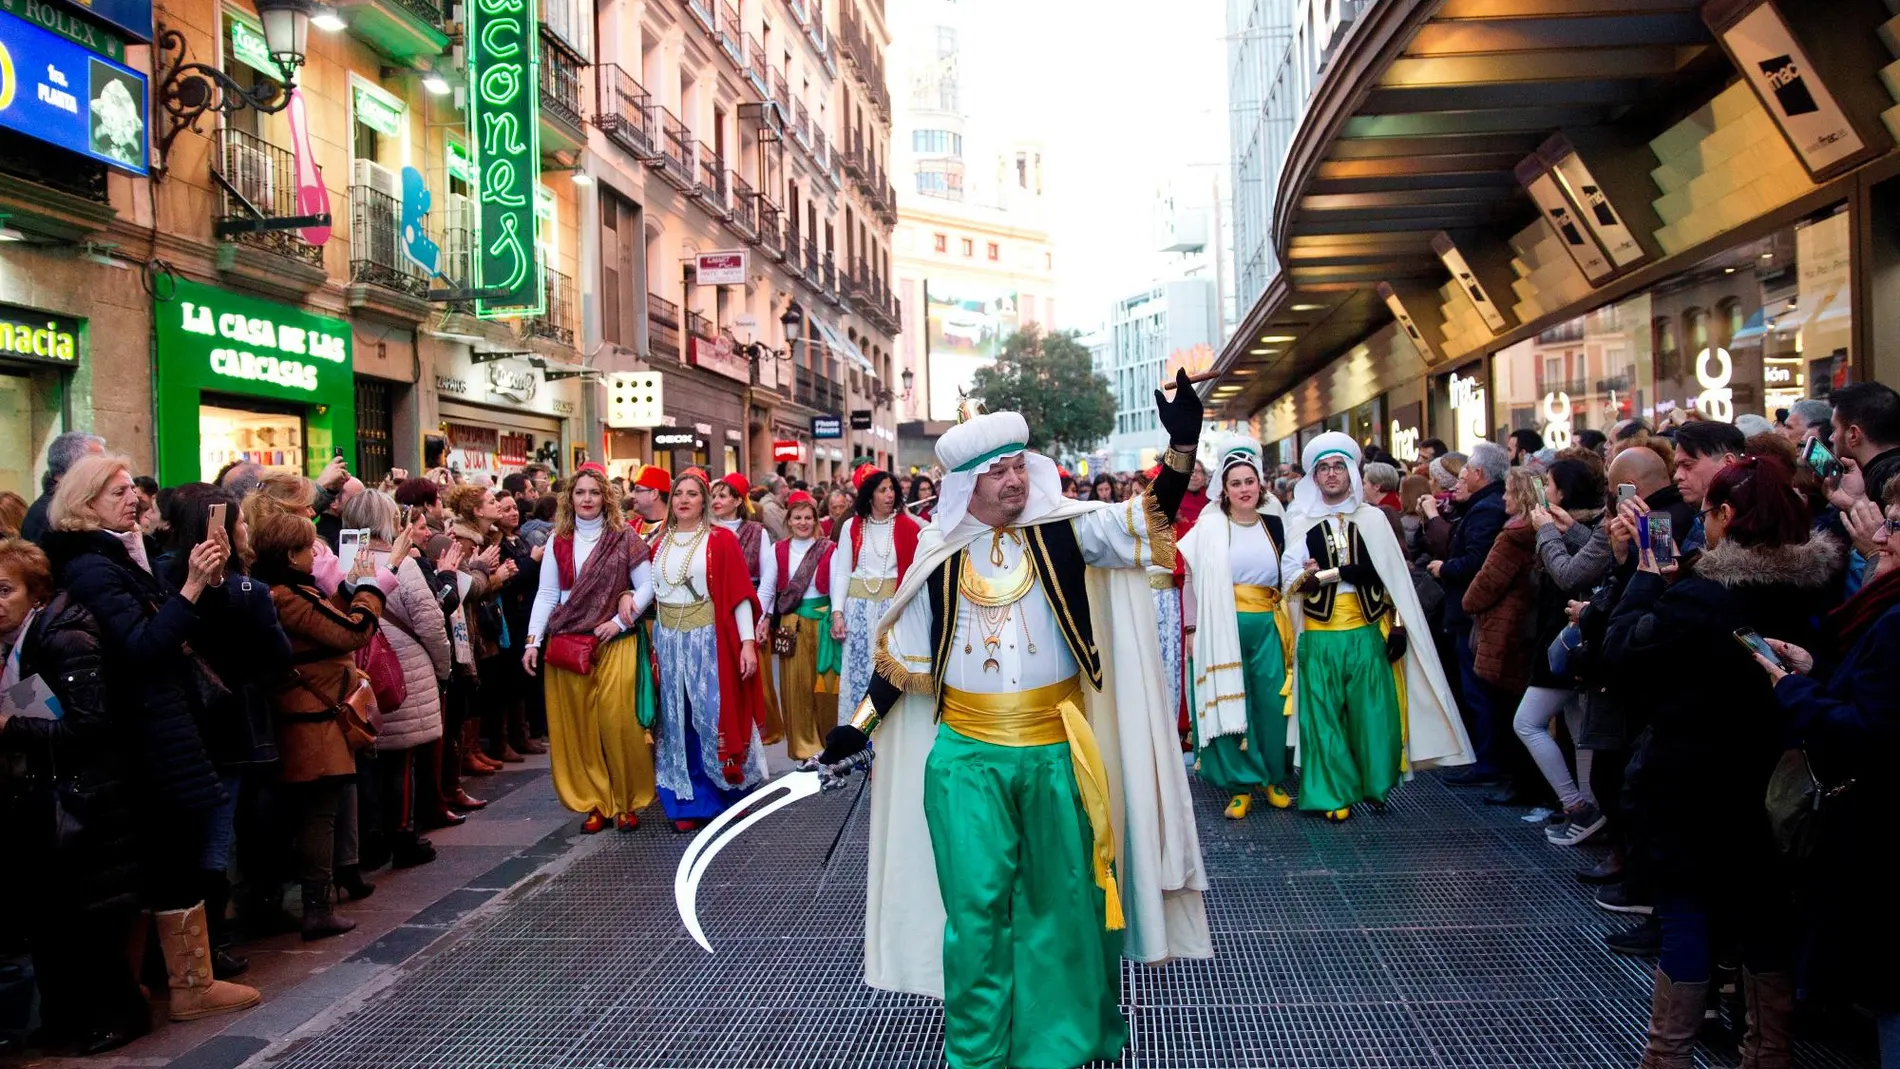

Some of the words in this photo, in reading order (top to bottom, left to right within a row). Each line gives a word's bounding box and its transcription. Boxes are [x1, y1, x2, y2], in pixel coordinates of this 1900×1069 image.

[25, 0, 97, 48] ROLEX
[181, 302, 216, 336] LA
[219, 313, 277, 348] CASA
[279, 325, 306, 354] DE
[308, 330, 346, 363] LAS
[210, 348, 318, 391] CARCASAS
[1449, 372, 1477, 410] fnac
[1391, 419, 1419, 462] fnac
